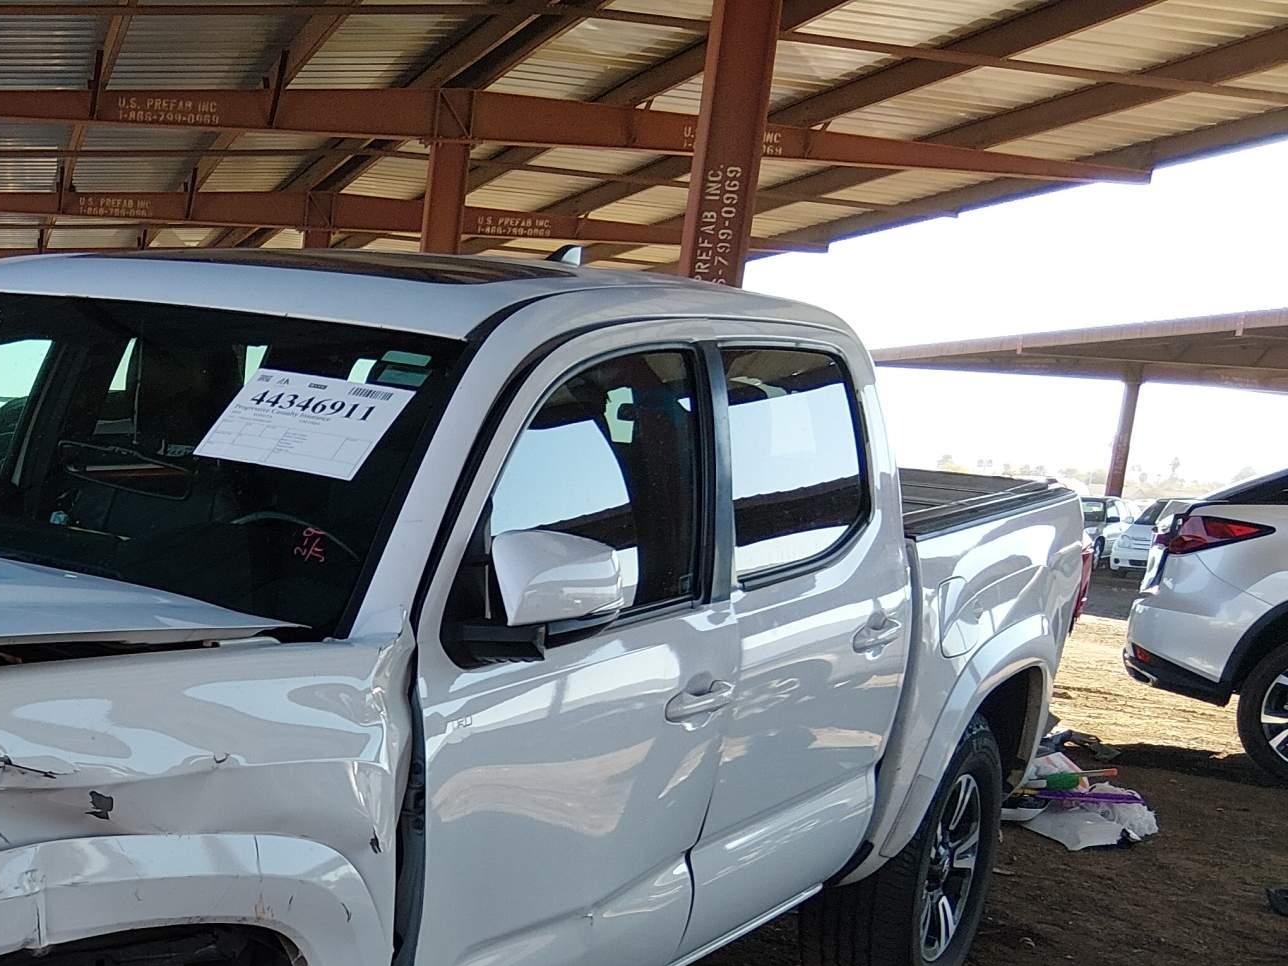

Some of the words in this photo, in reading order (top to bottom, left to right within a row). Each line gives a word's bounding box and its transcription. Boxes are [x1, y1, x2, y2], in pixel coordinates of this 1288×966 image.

[118, 96, 141, 110] U.S.
[146, 98, 192, 112] PREFAB
[198, 101, 217, 113] INC
[705, 164, 724, 200] INC.
[250, 389, 376, 422] 44346911
